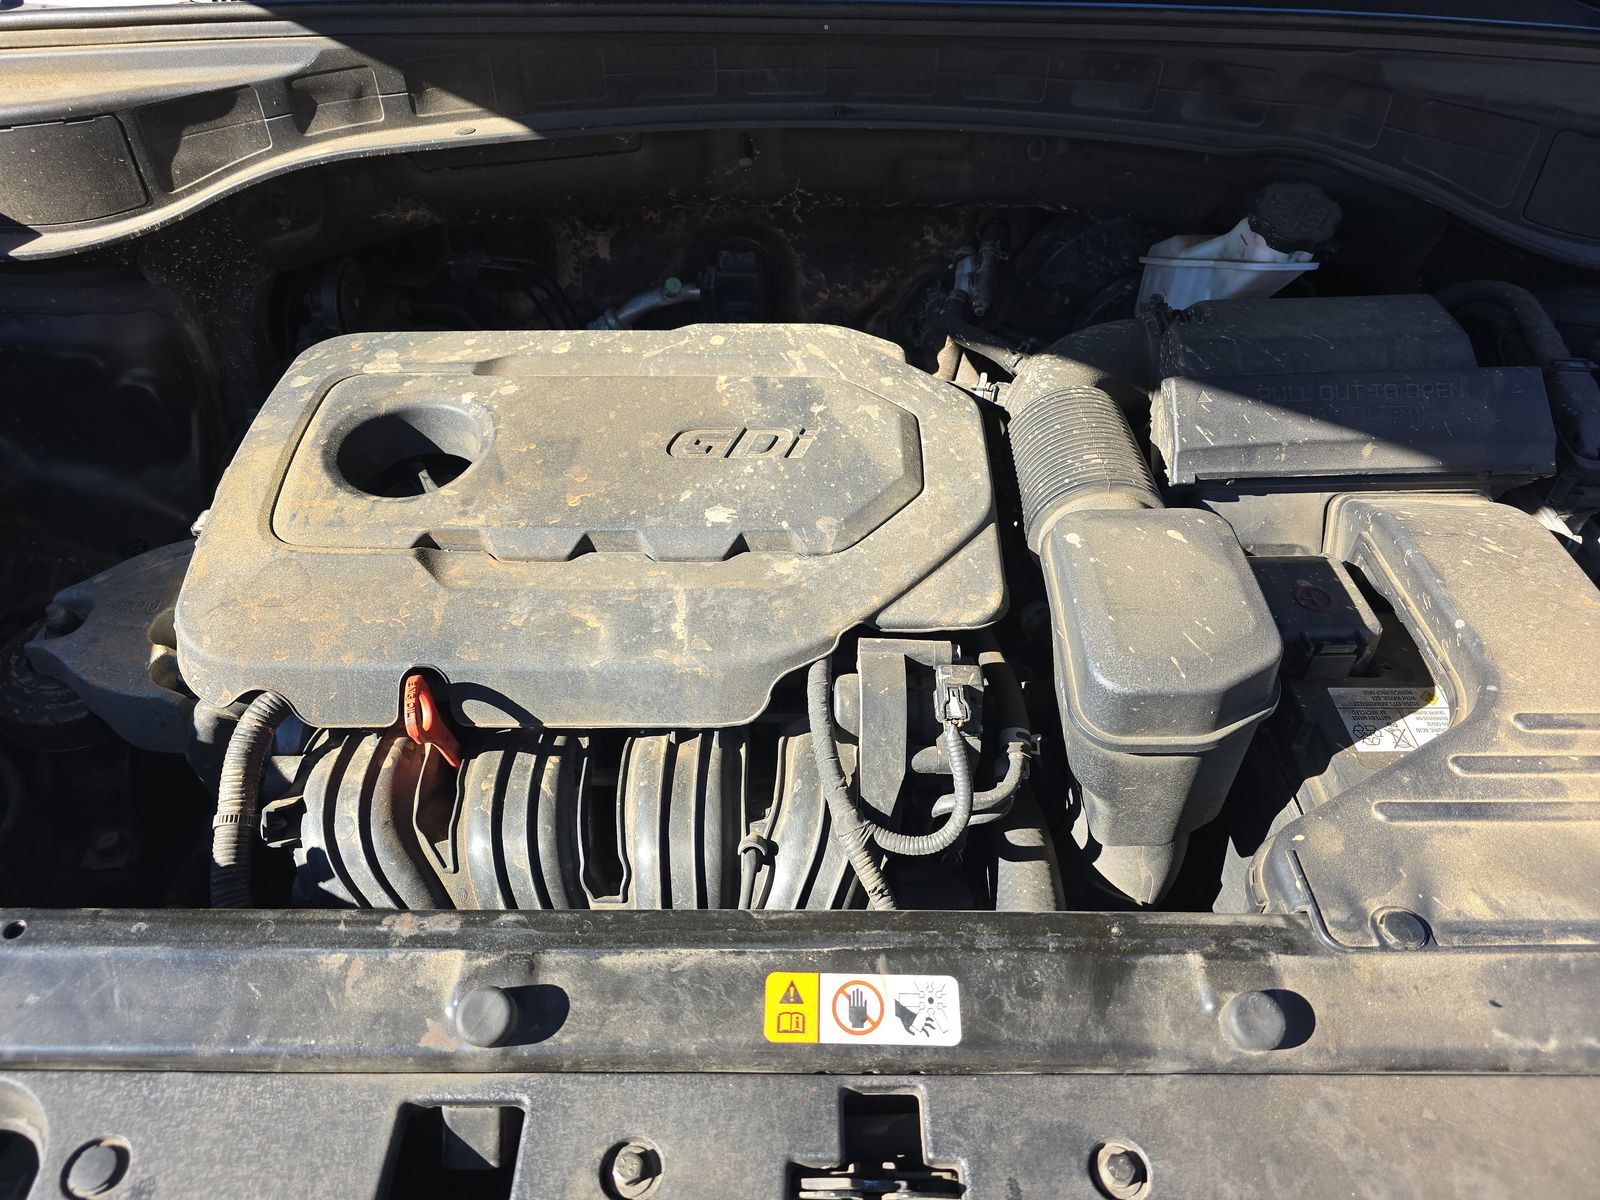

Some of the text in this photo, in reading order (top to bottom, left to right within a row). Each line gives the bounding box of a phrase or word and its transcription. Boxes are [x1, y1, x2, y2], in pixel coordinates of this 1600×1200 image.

[1258, 381, 1465, 402] PULL OUT TO OPEN
[665, 426, 820, 459] GDi
